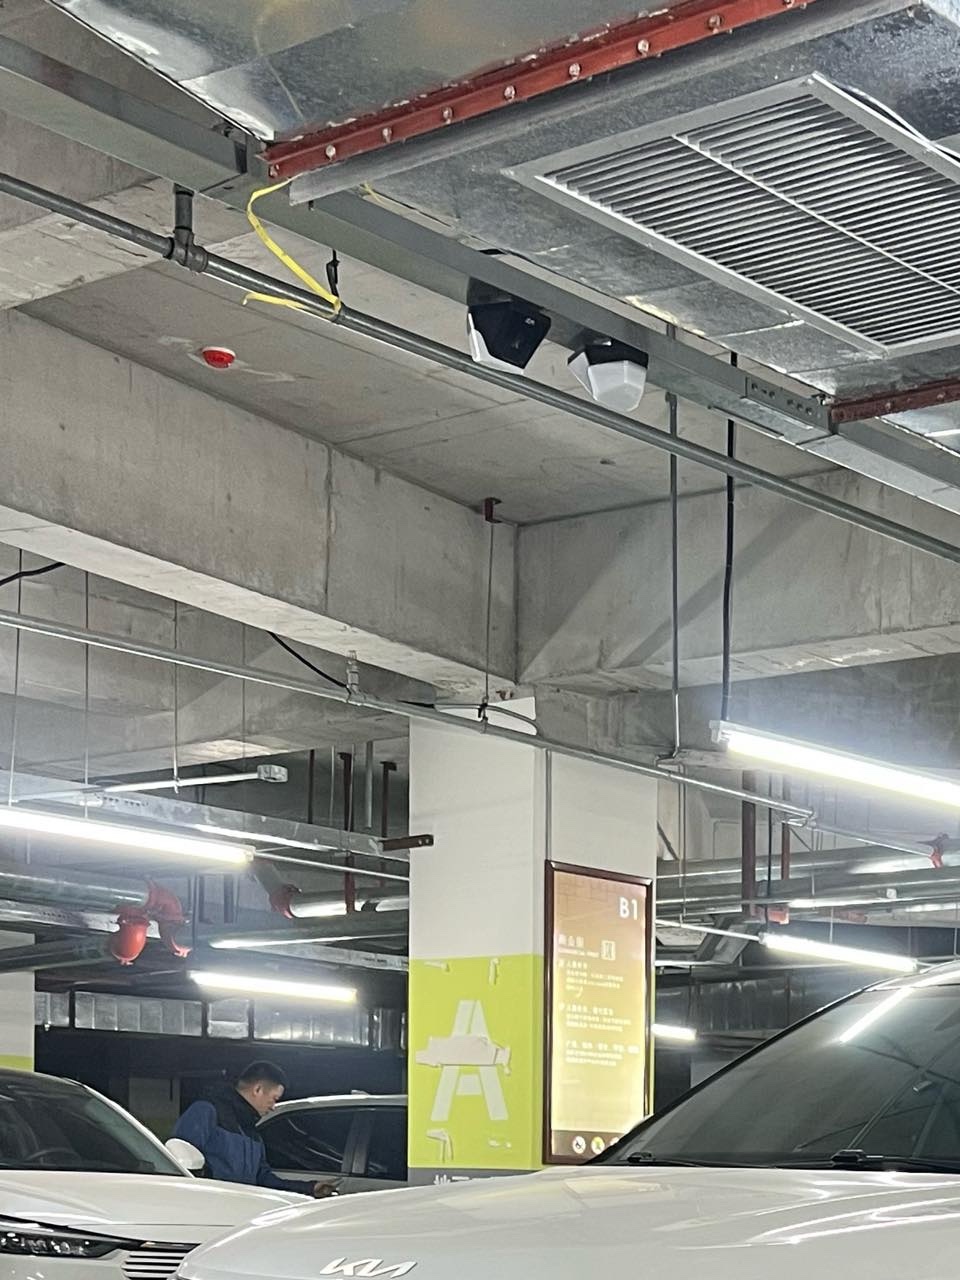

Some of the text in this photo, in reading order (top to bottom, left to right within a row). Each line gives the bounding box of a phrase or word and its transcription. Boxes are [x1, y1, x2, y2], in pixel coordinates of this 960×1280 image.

[620, 896, 638, 920] B1
[416, 999, 511, 1121] A
[319, 1257, 418, 1279] KIA
